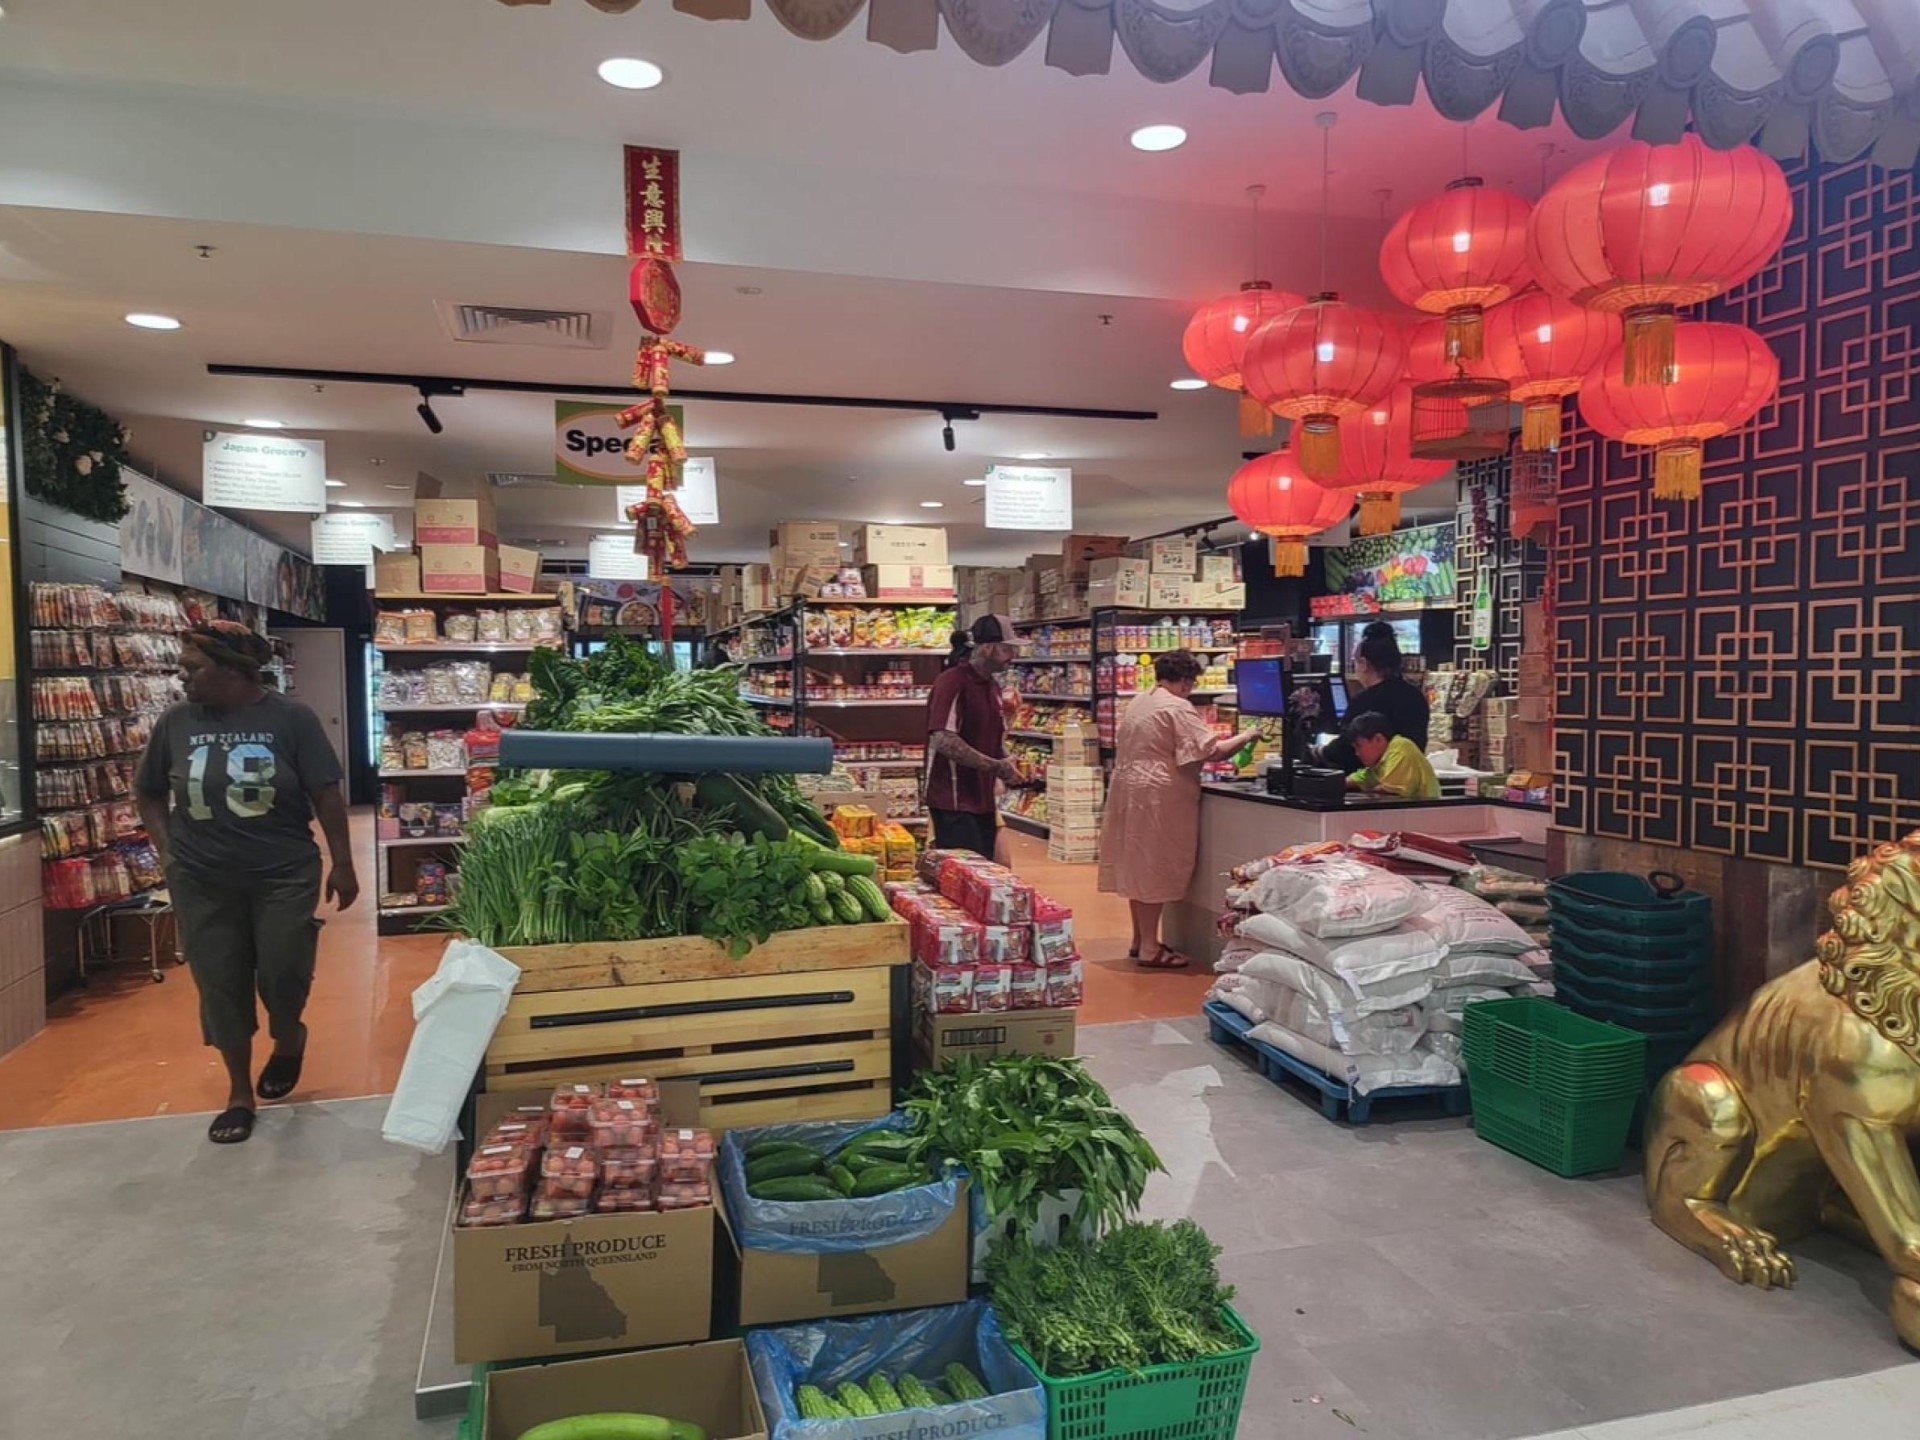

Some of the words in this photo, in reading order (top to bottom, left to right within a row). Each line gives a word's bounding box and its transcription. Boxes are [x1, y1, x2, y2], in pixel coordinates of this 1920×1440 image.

[222, 442, 258, 454] Japan
[261, 446, 306, 458] Grocery
[189, 733, 217, 746] NEW
[219, 732, 274, 744] ZEALAND
[187, 744, 276, 820] 18
[505, 1243, 567, 1263] FRESH
[573, 1234, 667, 1256] PRODUCE
[511, 1261, 542, 1273] FROM
[586, 1251, 658, 1268] QUEENSLAND
[917, 1413, 1007, 1440] PRODUCE
